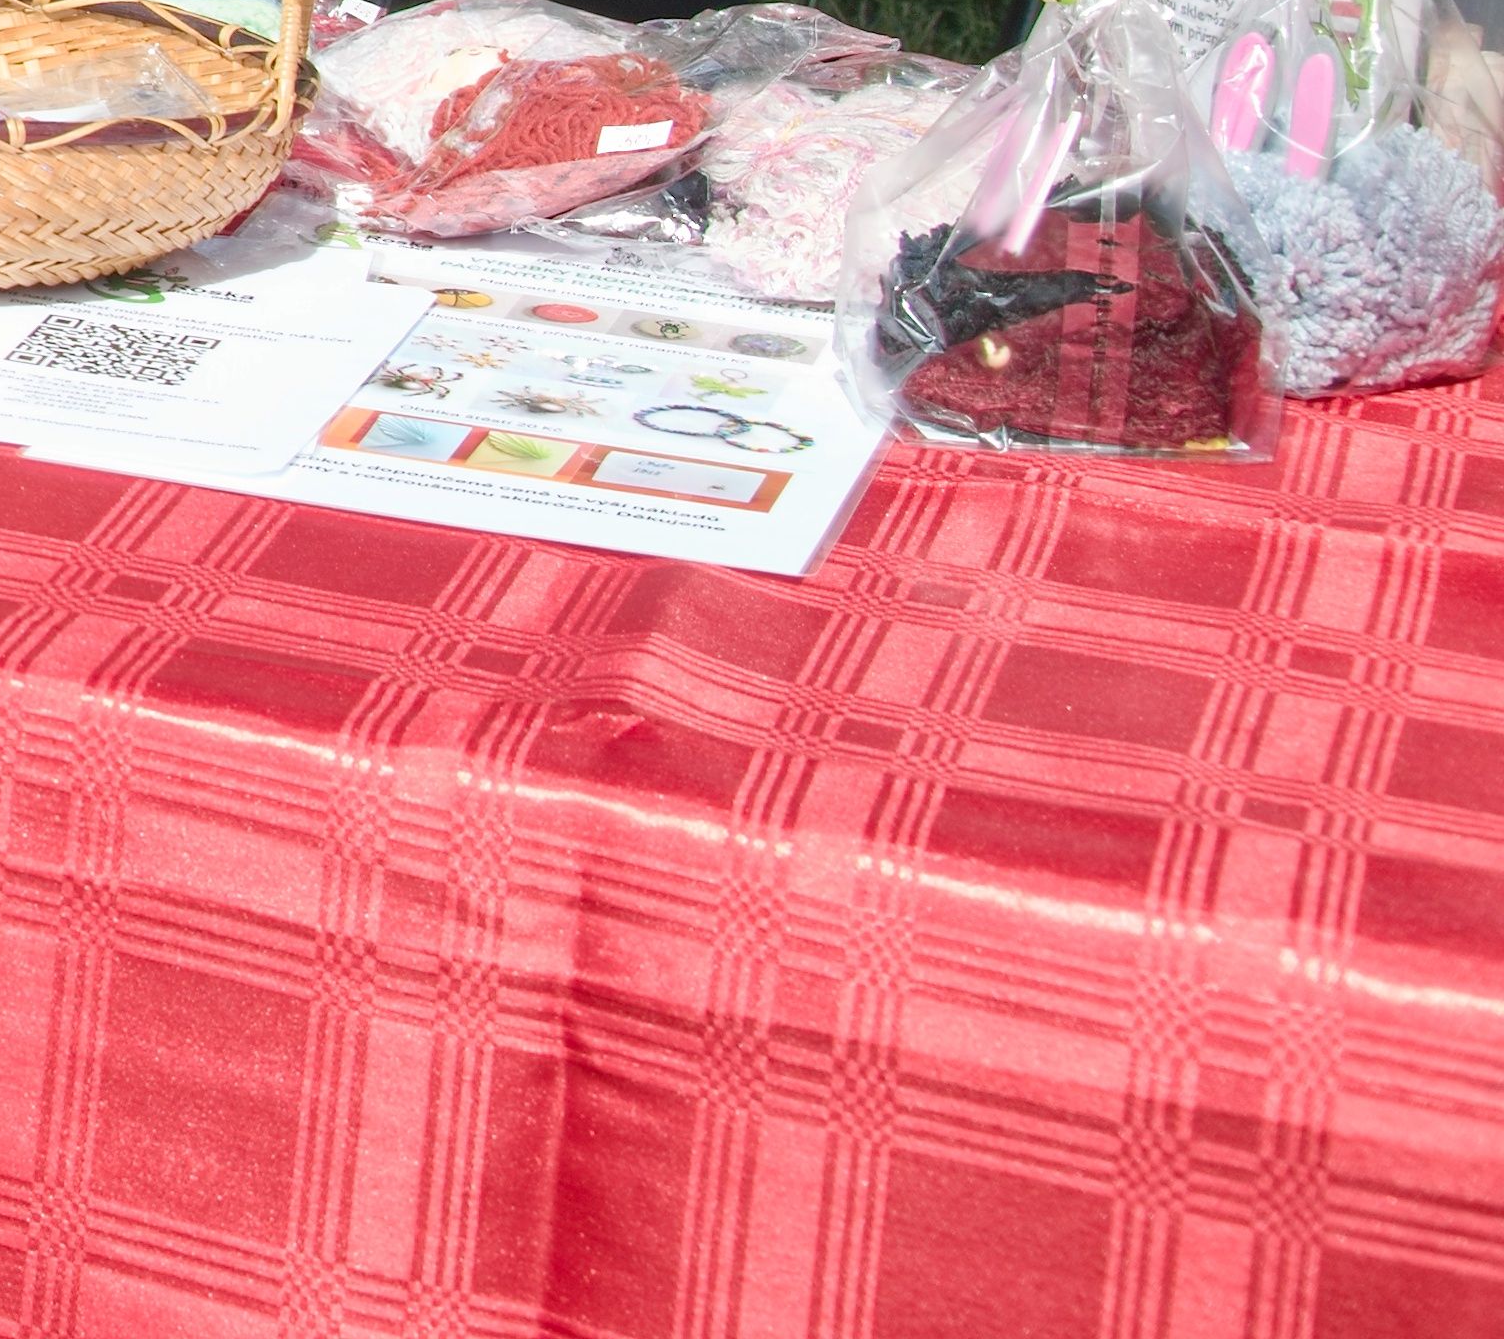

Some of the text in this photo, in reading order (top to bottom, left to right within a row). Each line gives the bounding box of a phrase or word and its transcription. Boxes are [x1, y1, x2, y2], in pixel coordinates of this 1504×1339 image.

[364, 234, 434, 250] Roska
[169, 283, 256, 301] Roska
[355, 472, 494, 498] roztroušenou
[499, 492, 610, 516] sklerózou.
[615, 510, 727, 533] Děkujeme
[366, 464, 494, 490] doporučené
[499, 483, 552, 498] ceně
[556, 492, 581, 501] ve
[585, 494, 628, 511] výši
[632, 502, 720, 523] nákladů
